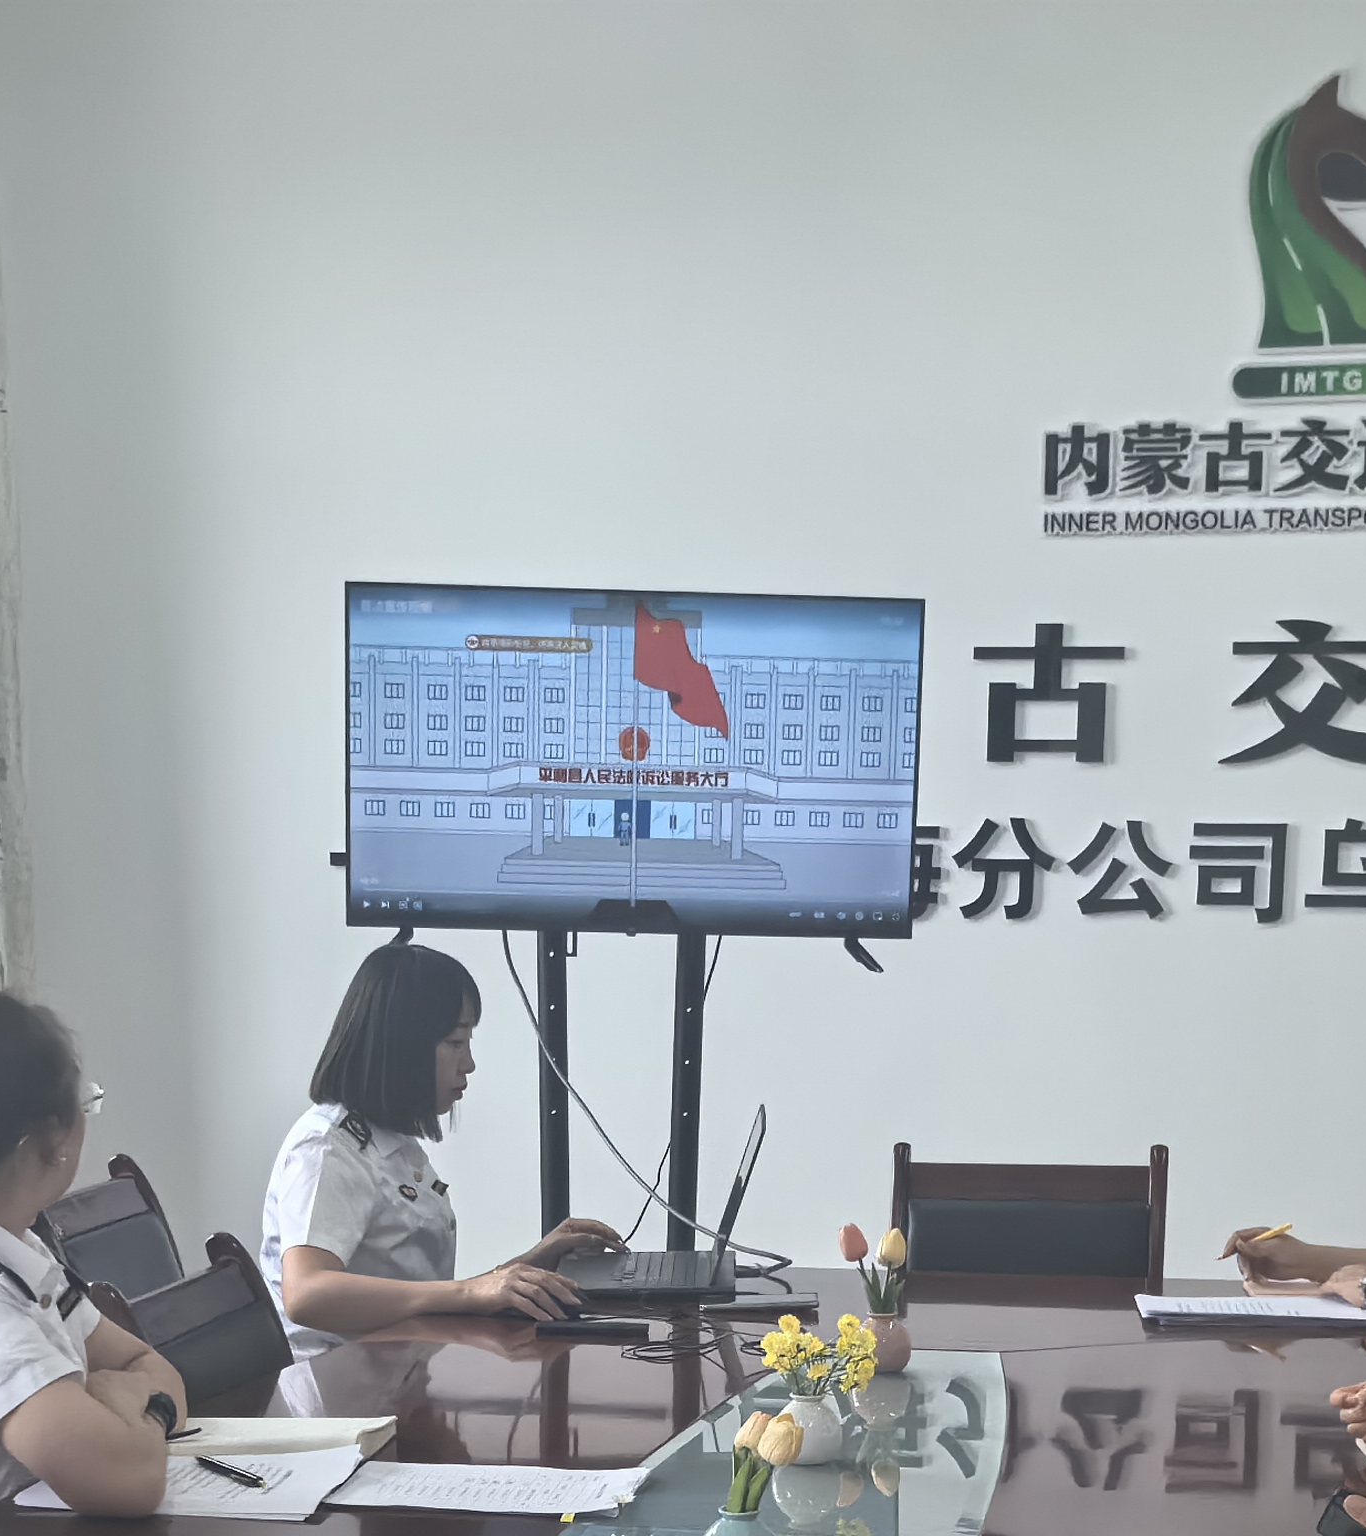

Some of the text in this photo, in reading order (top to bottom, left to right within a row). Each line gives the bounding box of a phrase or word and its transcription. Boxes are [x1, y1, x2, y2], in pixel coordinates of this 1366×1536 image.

[1280, 369, 1363, 394] IMTG
[1043, 511, 1117, 533] INNER
[1124, 509, 1258, 531] MONGOLIA
